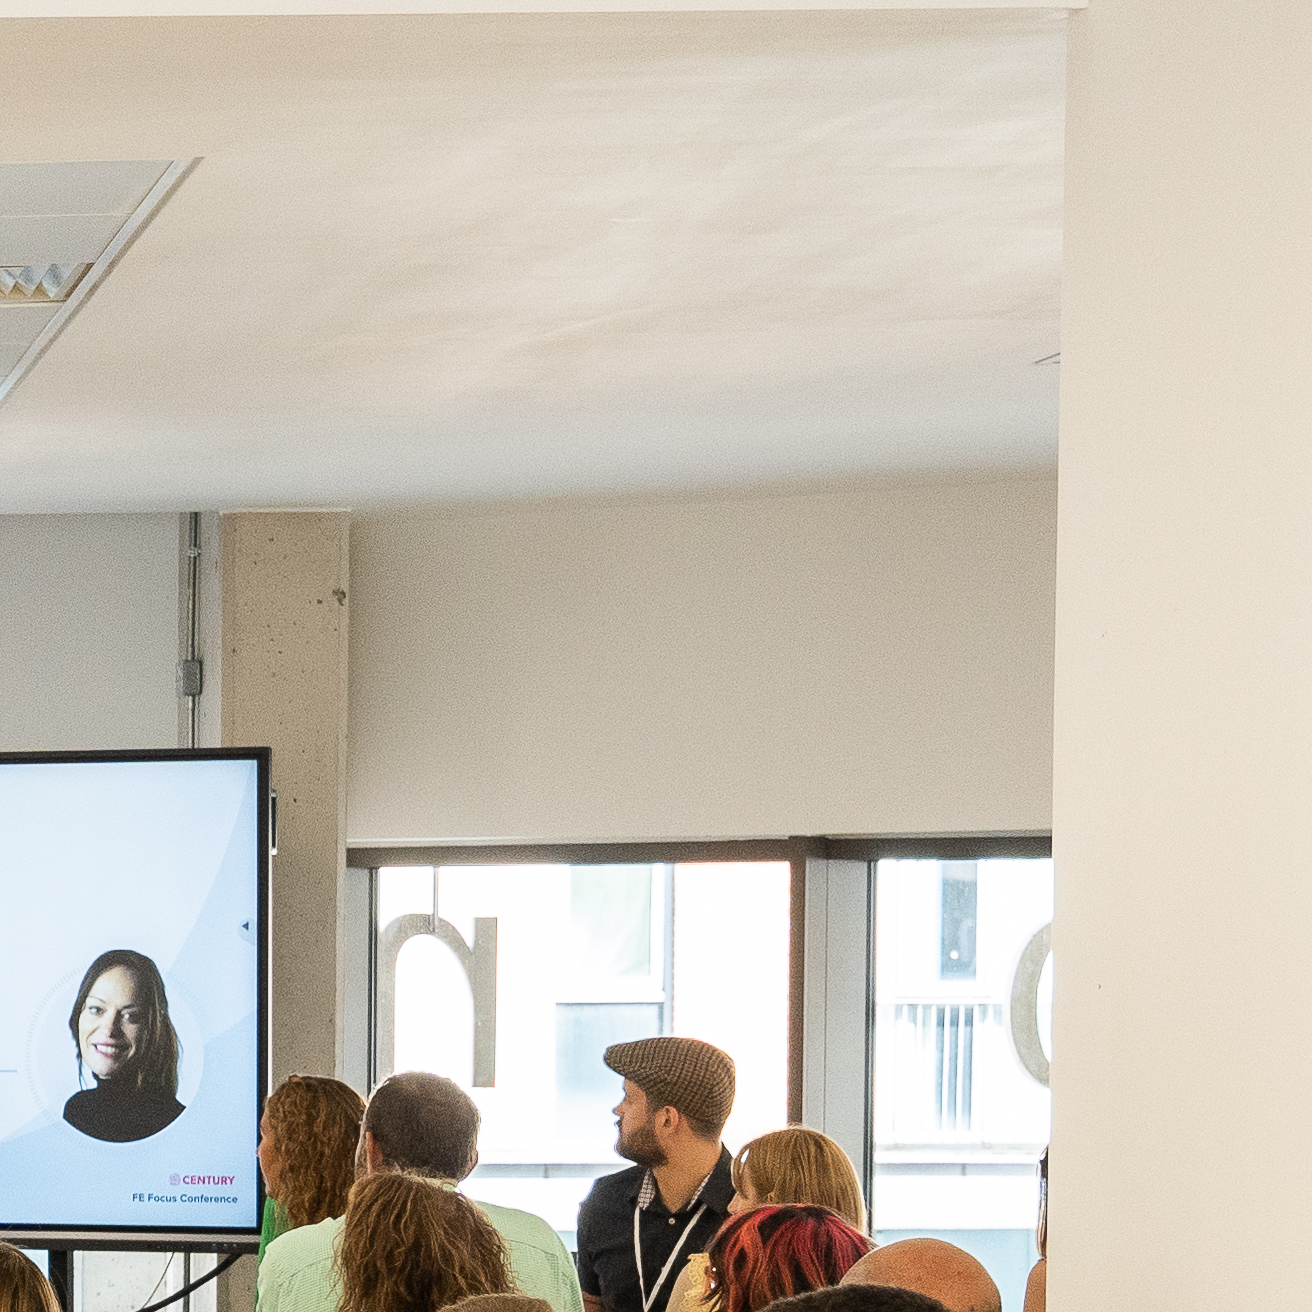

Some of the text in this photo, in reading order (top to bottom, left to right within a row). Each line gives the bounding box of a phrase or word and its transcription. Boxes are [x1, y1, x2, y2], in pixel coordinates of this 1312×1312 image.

[182, 1175, 235, 1185] CENTURY
[132, 1193, 238, 1204] FE Focus Conference
